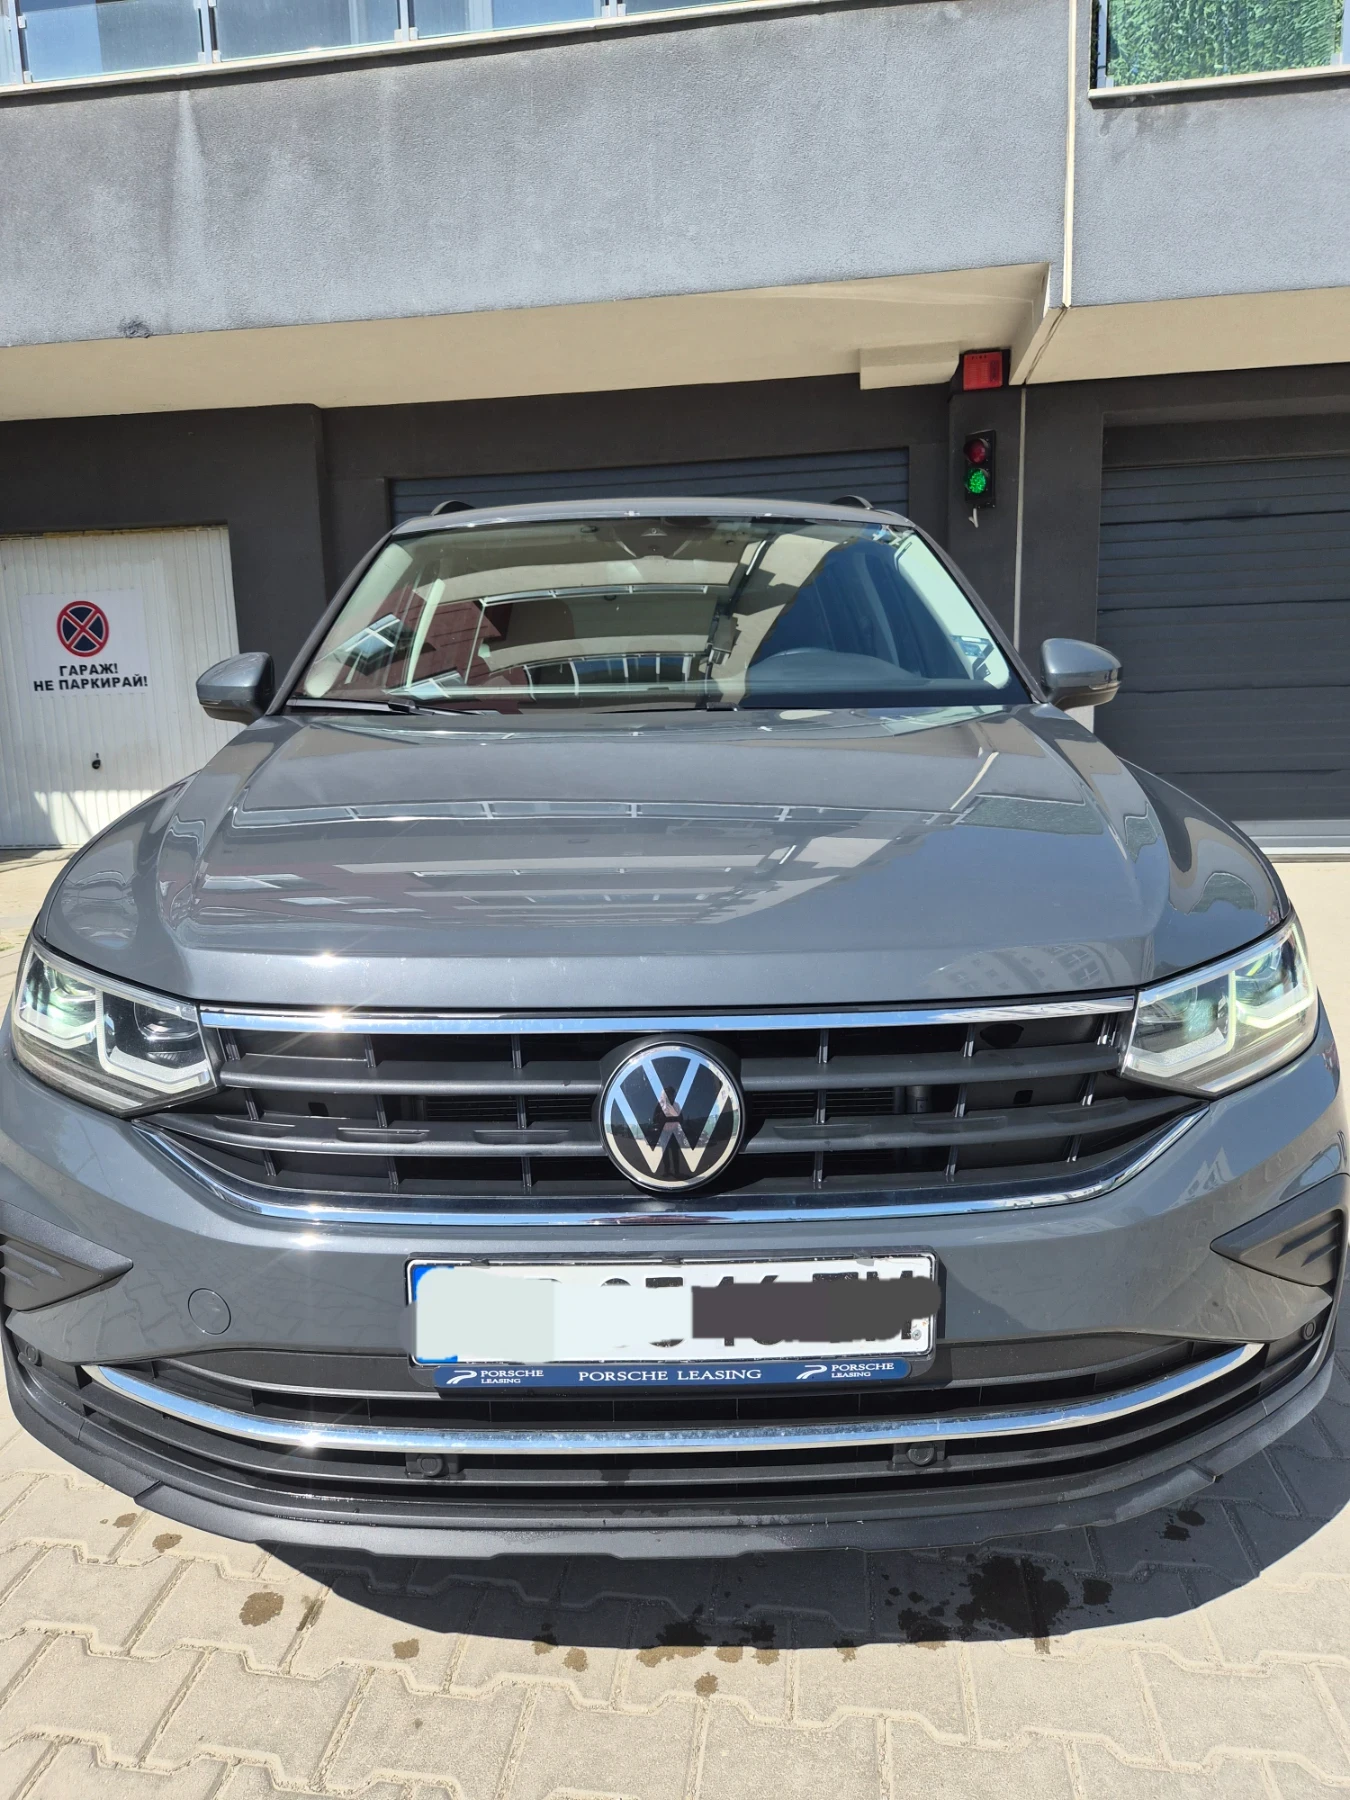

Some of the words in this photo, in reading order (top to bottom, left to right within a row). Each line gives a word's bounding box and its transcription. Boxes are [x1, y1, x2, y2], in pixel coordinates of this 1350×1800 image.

[59, 663, 118, 676] ГАРАЖ!
[33, 680, 54, 691] НЕ
[59, 674, 148, 690] ПАРКИРАЙ!
[831, 1363, 895, 1371] PORSCHE
[578, 1371, 669, 1381] PORSCHE
[677, 1369, 762, 1380] LEASING
